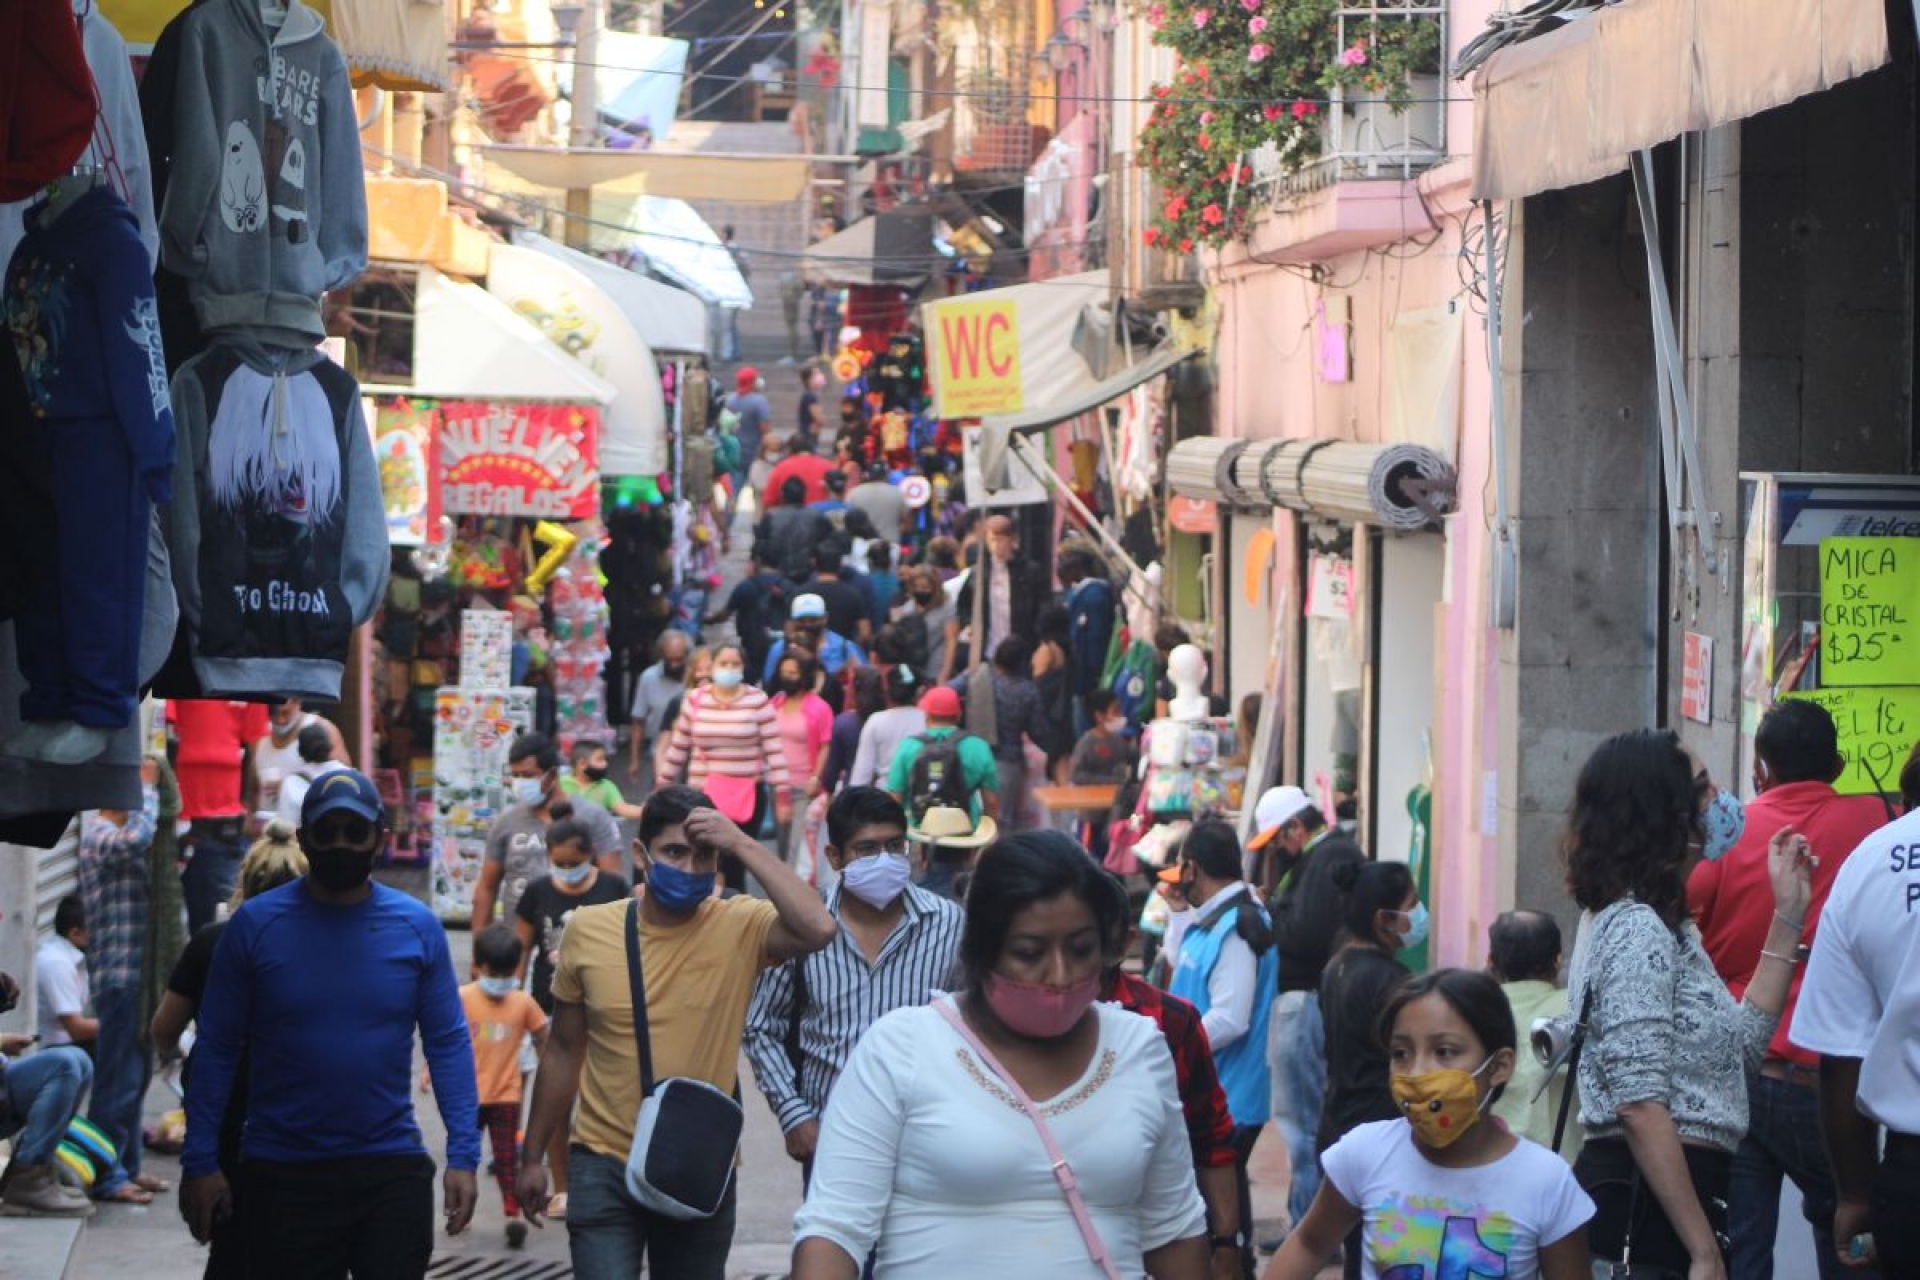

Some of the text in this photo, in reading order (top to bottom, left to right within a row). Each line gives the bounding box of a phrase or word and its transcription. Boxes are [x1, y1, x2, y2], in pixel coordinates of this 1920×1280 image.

[941, 312, 1013, 380] WC
[1825, 547, 1896, 580] MICA
[1842, 583, 1869, 600] DE
[1823, 603, 1907, 628] CRISTAL
